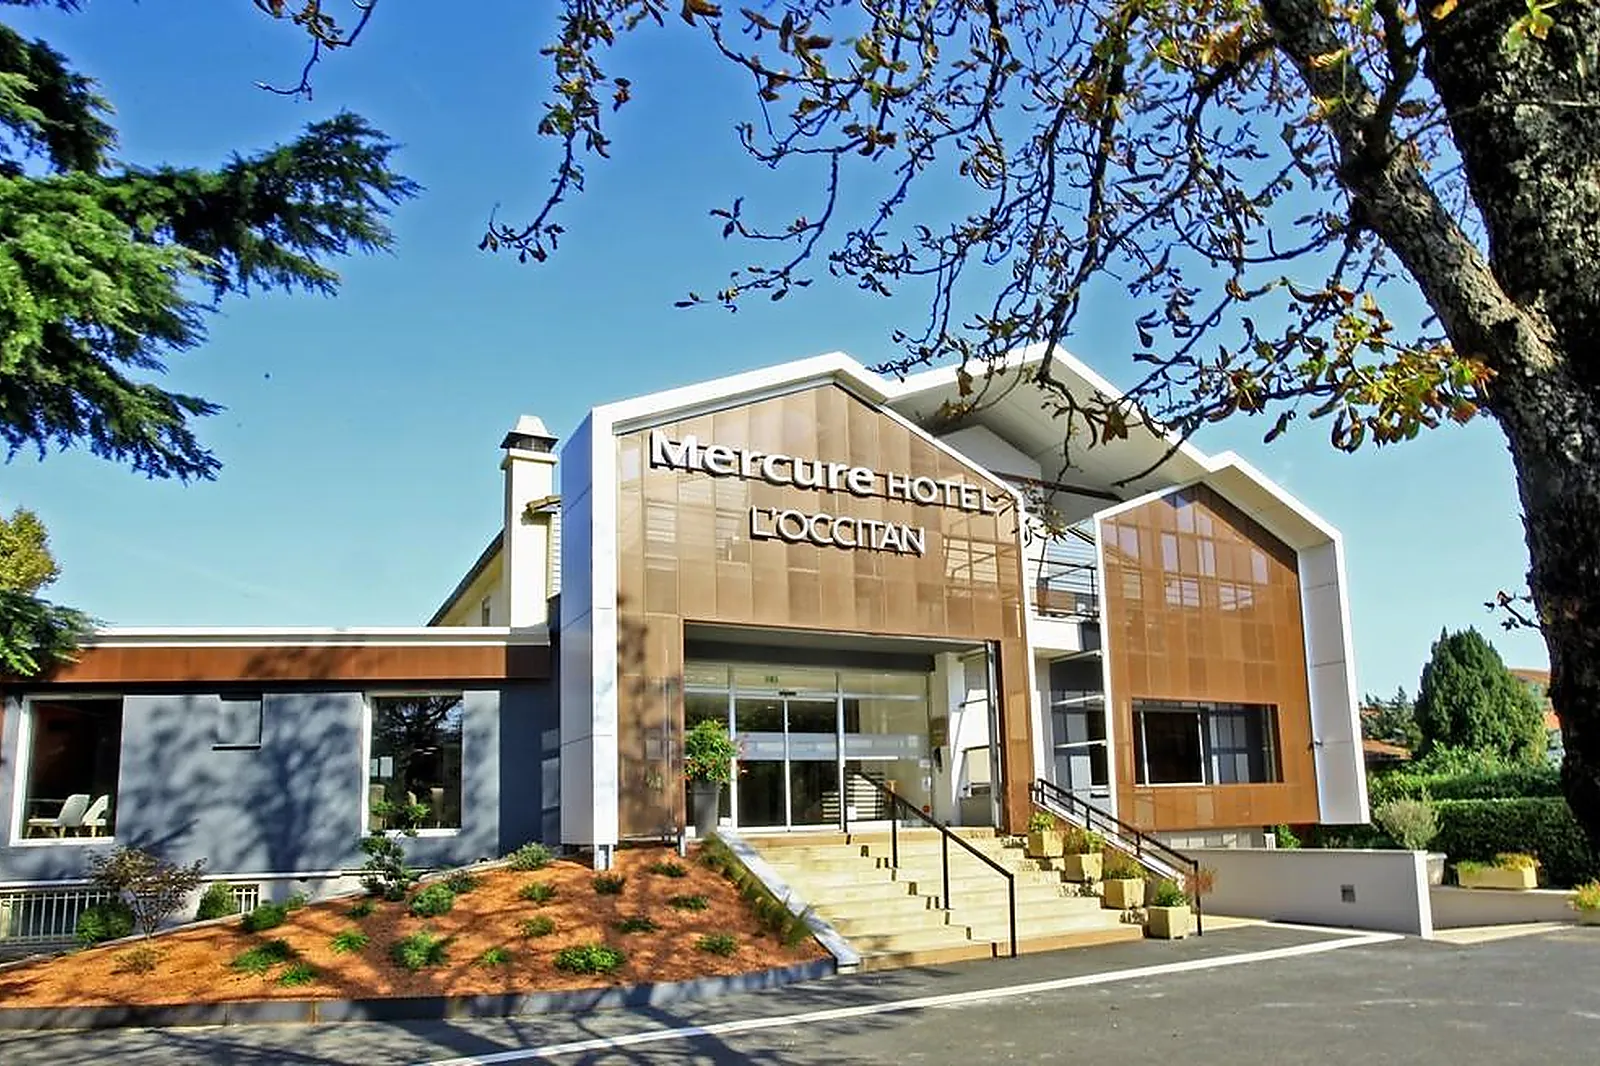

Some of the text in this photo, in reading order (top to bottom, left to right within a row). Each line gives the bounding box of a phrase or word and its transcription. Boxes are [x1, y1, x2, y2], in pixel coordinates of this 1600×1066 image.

[651, 429, 998, 513] Mercure HOTEL
[750, 505, 926, 556] L'OCCITAN
